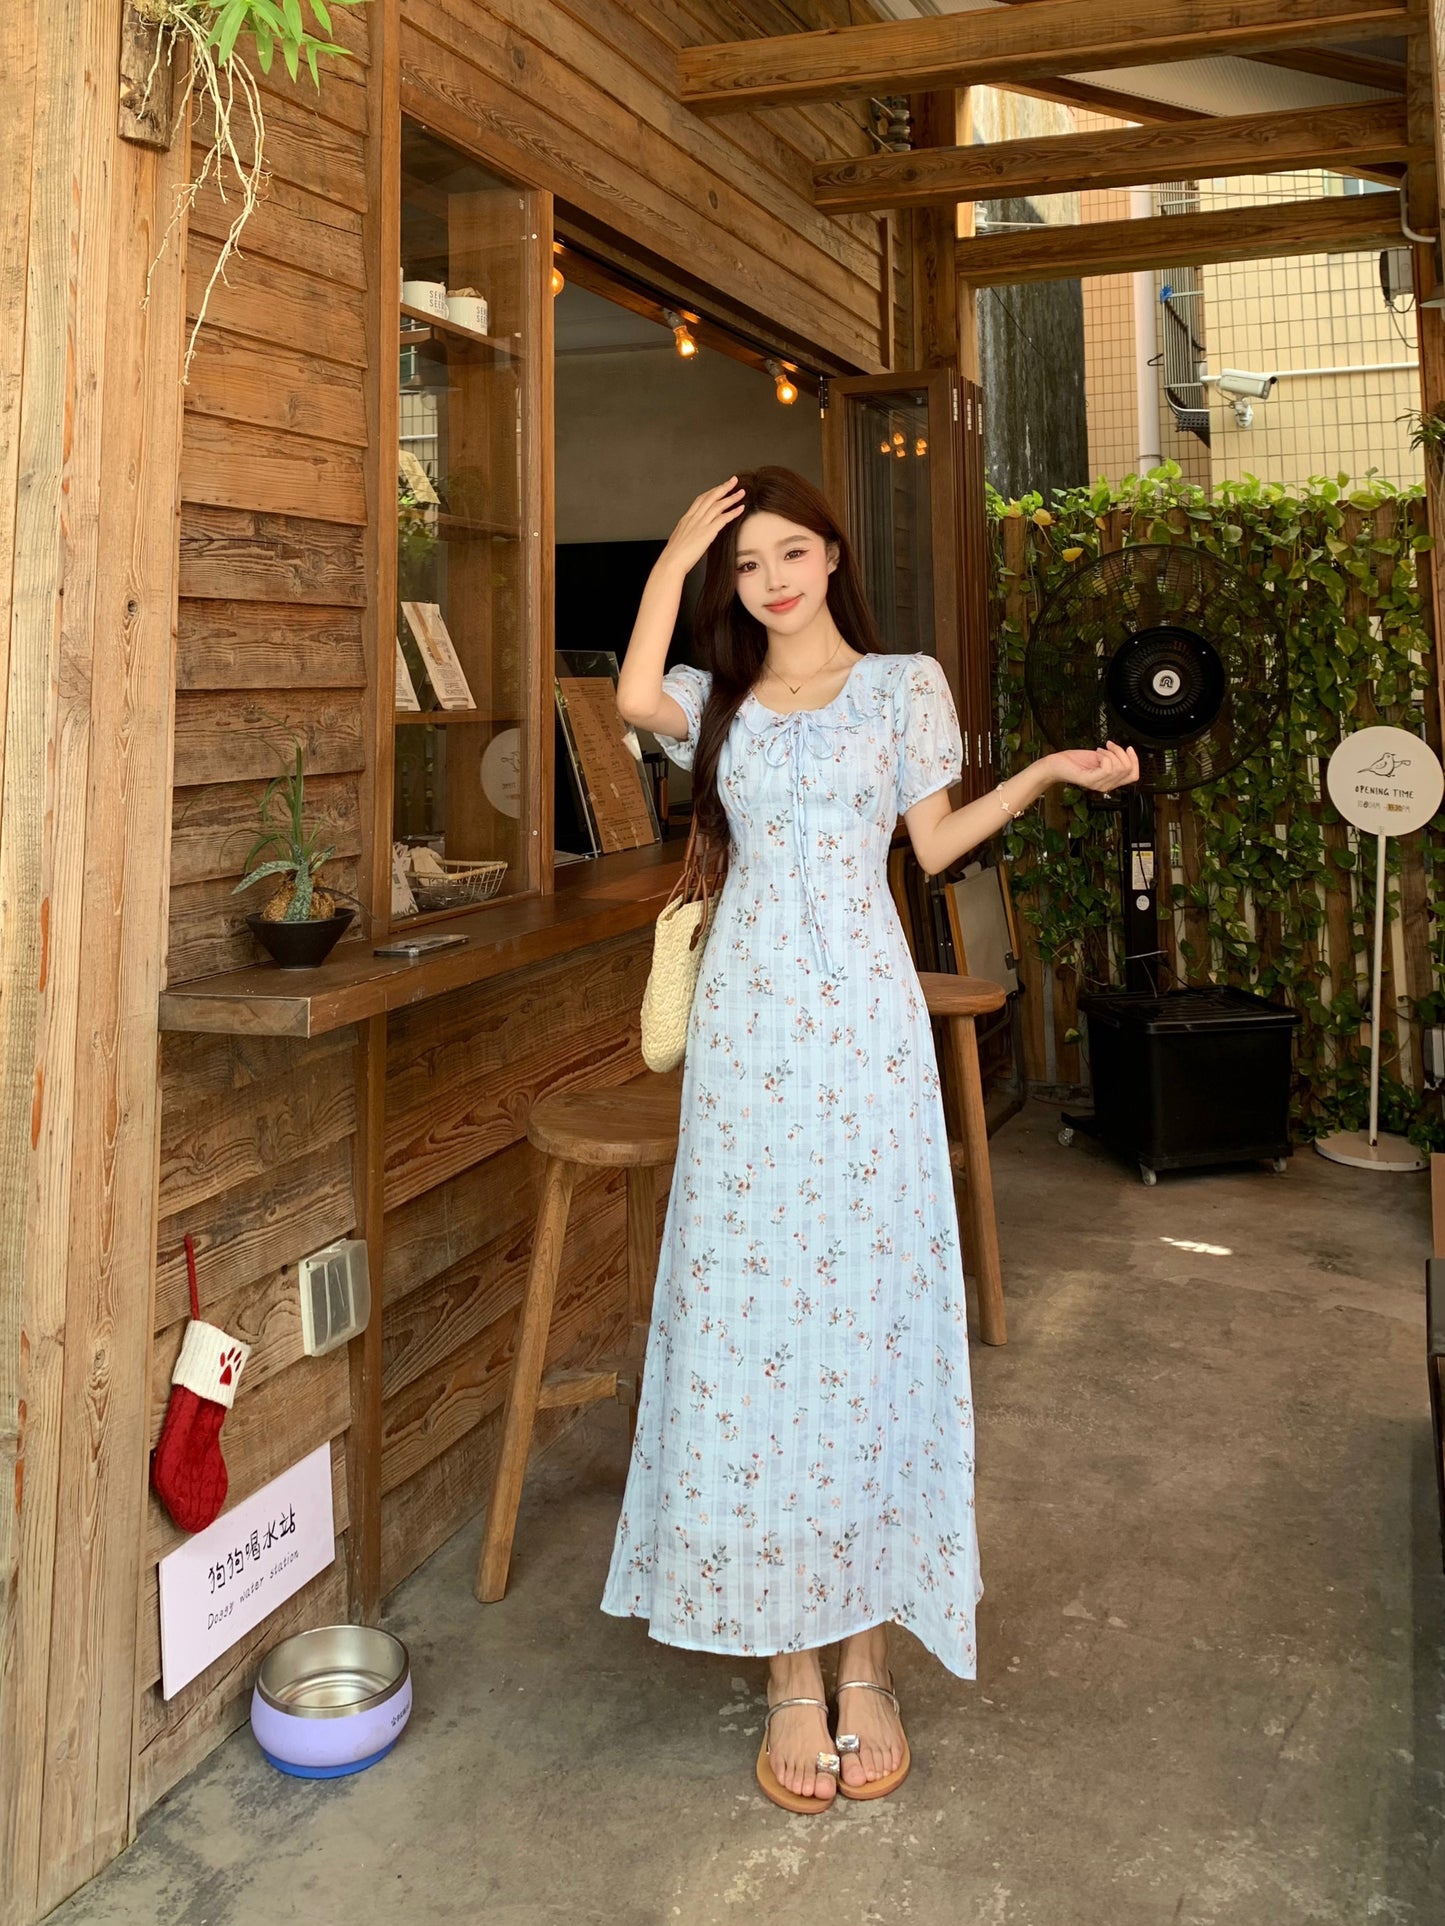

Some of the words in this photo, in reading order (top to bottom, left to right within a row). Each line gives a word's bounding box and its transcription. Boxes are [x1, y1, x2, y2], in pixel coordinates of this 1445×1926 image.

[1355, 785, 1389, 796] OPENING
[1393, 789, 1414, 799] TIME
[208, 1503, 296, 1594] 狗狗喝水站
[240, 1576, 265, 1603] water
[269, 1549, 300, 1579] station
